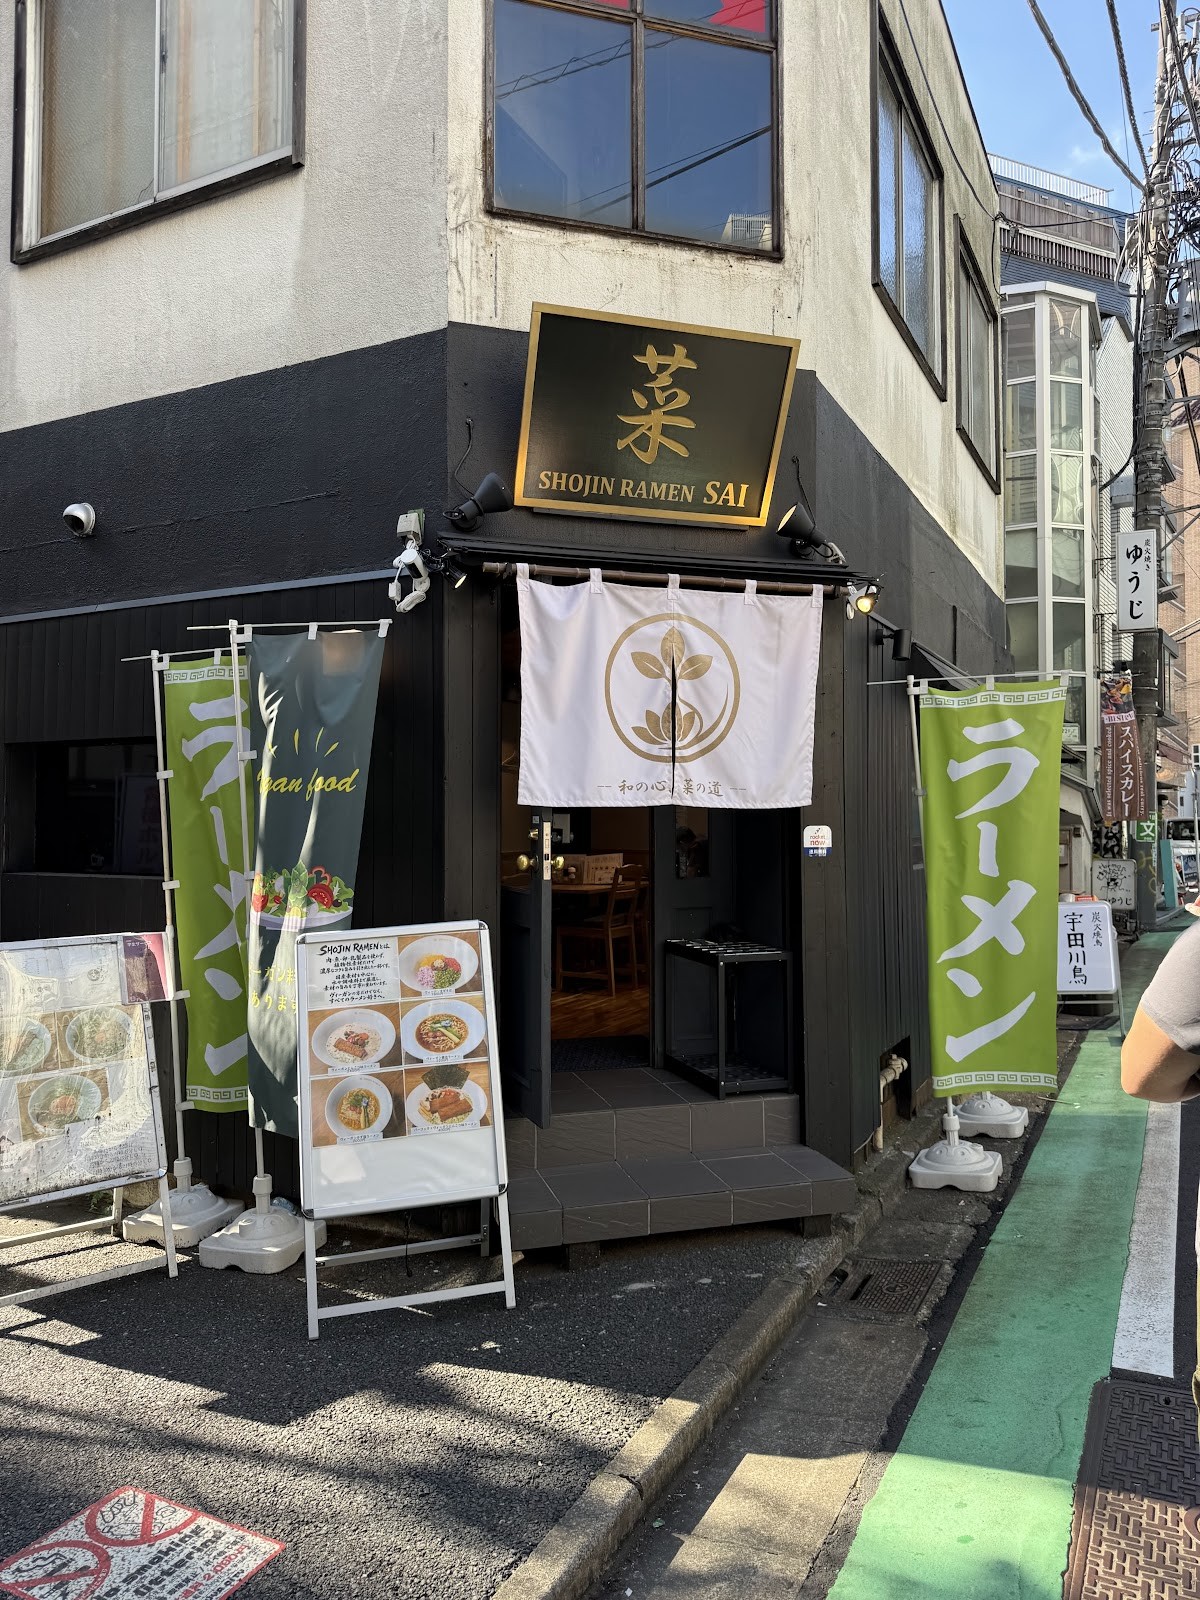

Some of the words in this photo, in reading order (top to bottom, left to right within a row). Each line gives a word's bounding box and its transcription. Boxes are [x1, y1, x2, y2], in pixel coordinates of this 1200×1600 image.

[616, 343, 698, 464] 菜
[538, 470, 615, 497] SHOJIN
[619, 479, 695, 503] RAMEN
[703, 481, 749, 507] SAI
[1126, 544, 1144, 620] ゆうじ
[1144, 538, 1152, 572] 炭火焼き
[305, 767, 360, 801] food
[1118, 725, 1135, 817] スパイスカレー
[1139, 820, 1155, 837] 文
[936, 718, 1040, 1063] ラーメン
[316, 944, 352, 956] SHOJIN
[1064, 911, 1088, 985] 宇田川鳥
